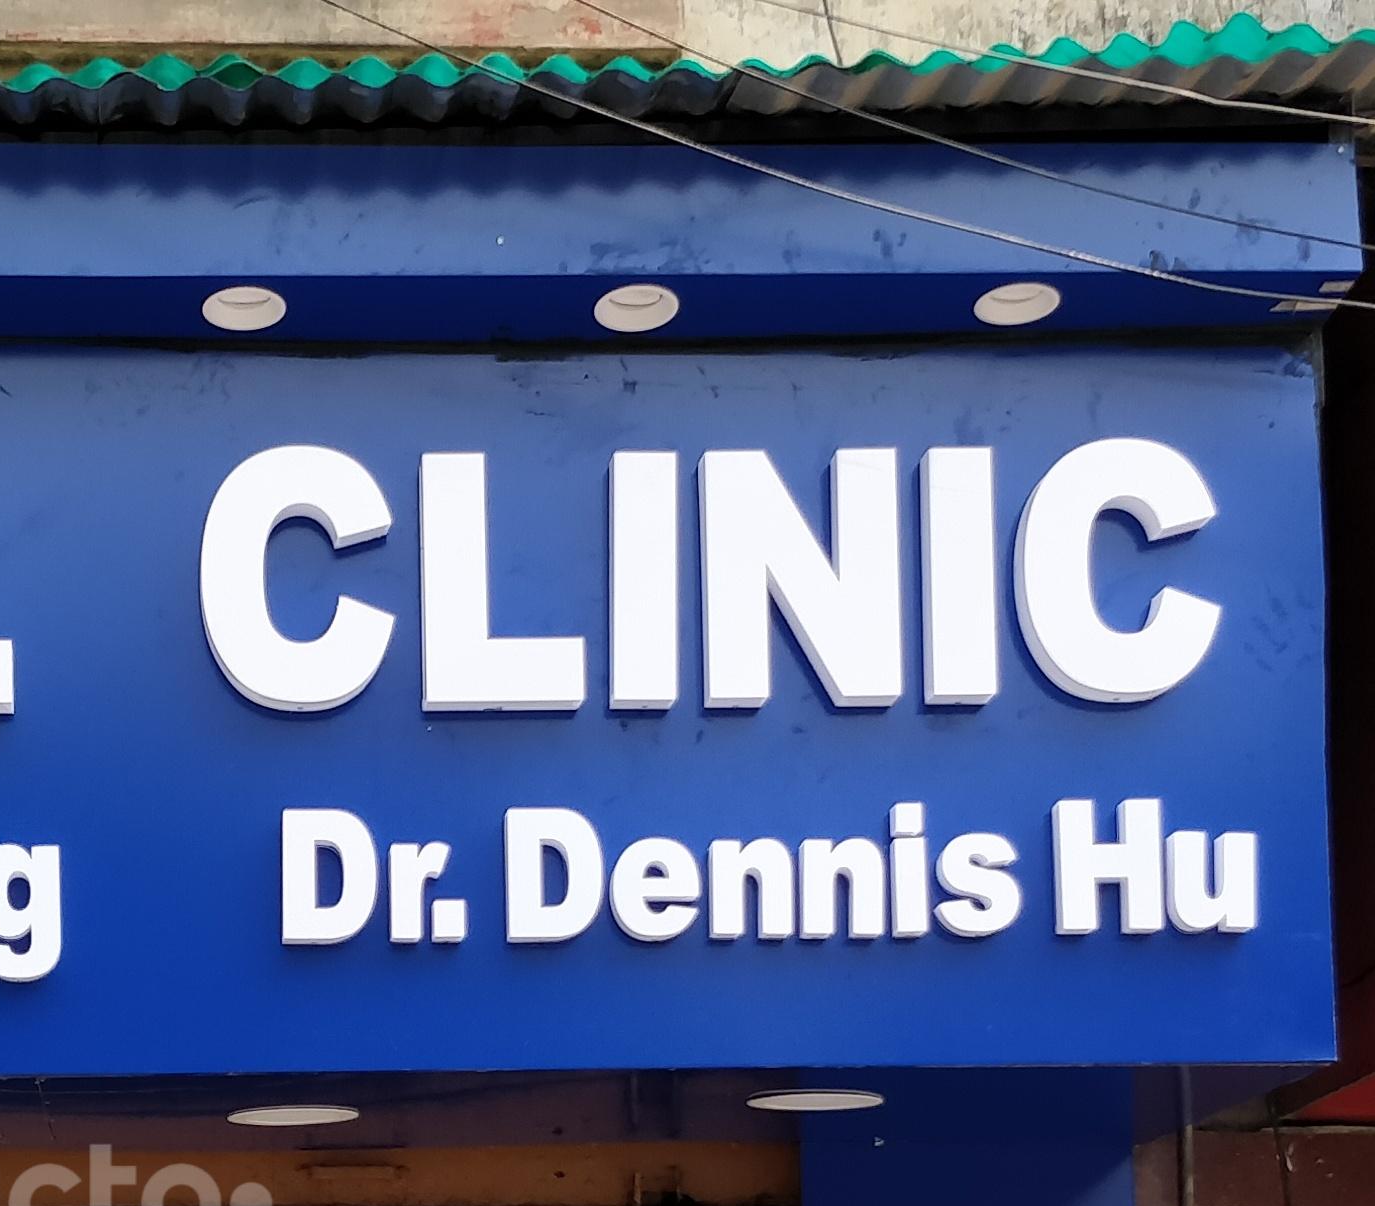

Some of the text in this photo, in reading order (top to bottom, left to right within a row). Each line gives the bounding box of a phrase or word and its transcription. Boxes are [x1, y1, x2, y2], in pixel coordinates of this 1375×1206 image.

[200, 438, 1223, 712] CLINIC
[281, 798, 1258, 946] Dr. Dennis Hu
